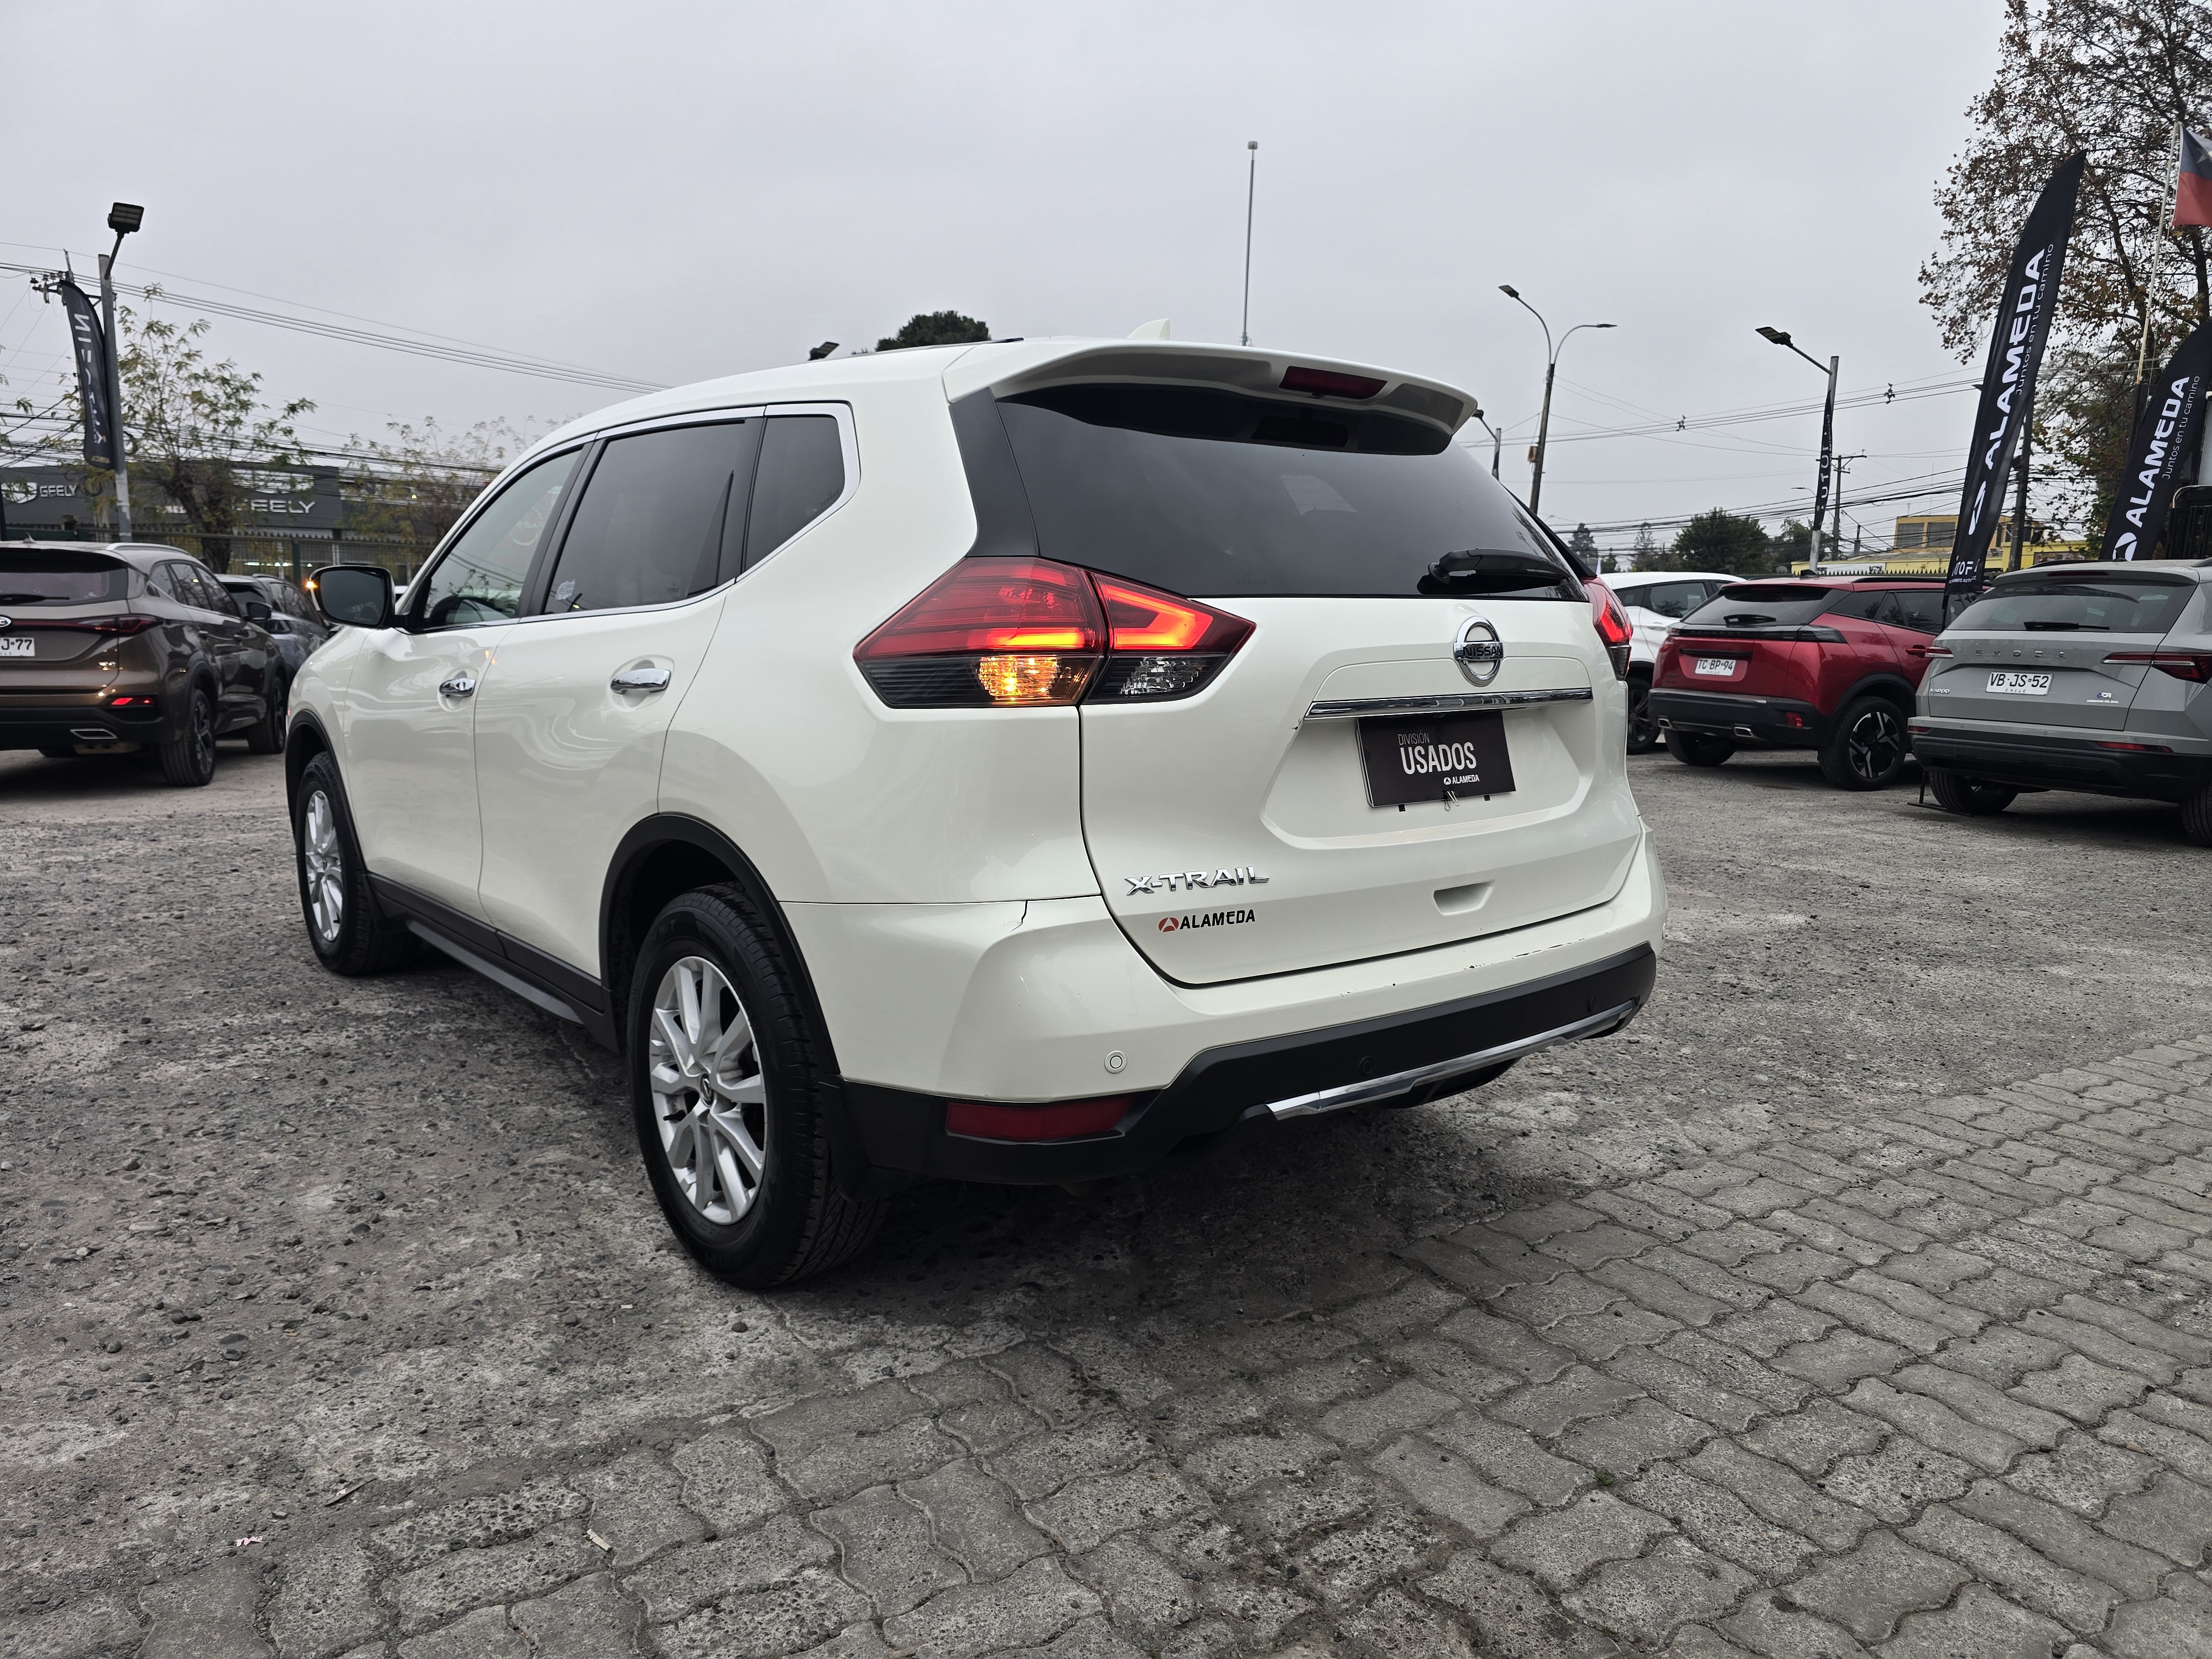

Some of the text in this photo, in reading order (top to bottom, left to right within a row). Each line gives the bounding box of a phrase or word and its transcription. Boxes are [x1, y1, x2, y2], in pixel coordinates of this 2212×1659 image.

[2015, 244, 2053, 395] Juntos en tu camino
[1985, 249, 2044, 470] ALAMEDA
[2162, 376, 2200, 479] Juntos en tu camino
[2126, 377, 2190, 528] ALAMEDA
[40, 484, 77, 497] GEELY
[1463, 646, 1501, 656] NISSAN
[1397, 729, 1430, 745] DIVISIÓN
[1400, 742, 1477, 775] USADOS
[1452, 774, 1480, 785] ALAMEDA
[1124, 865, 1270, 896] X-TRAIL
[1180, 909, 1255, 930] ALAMEDA
